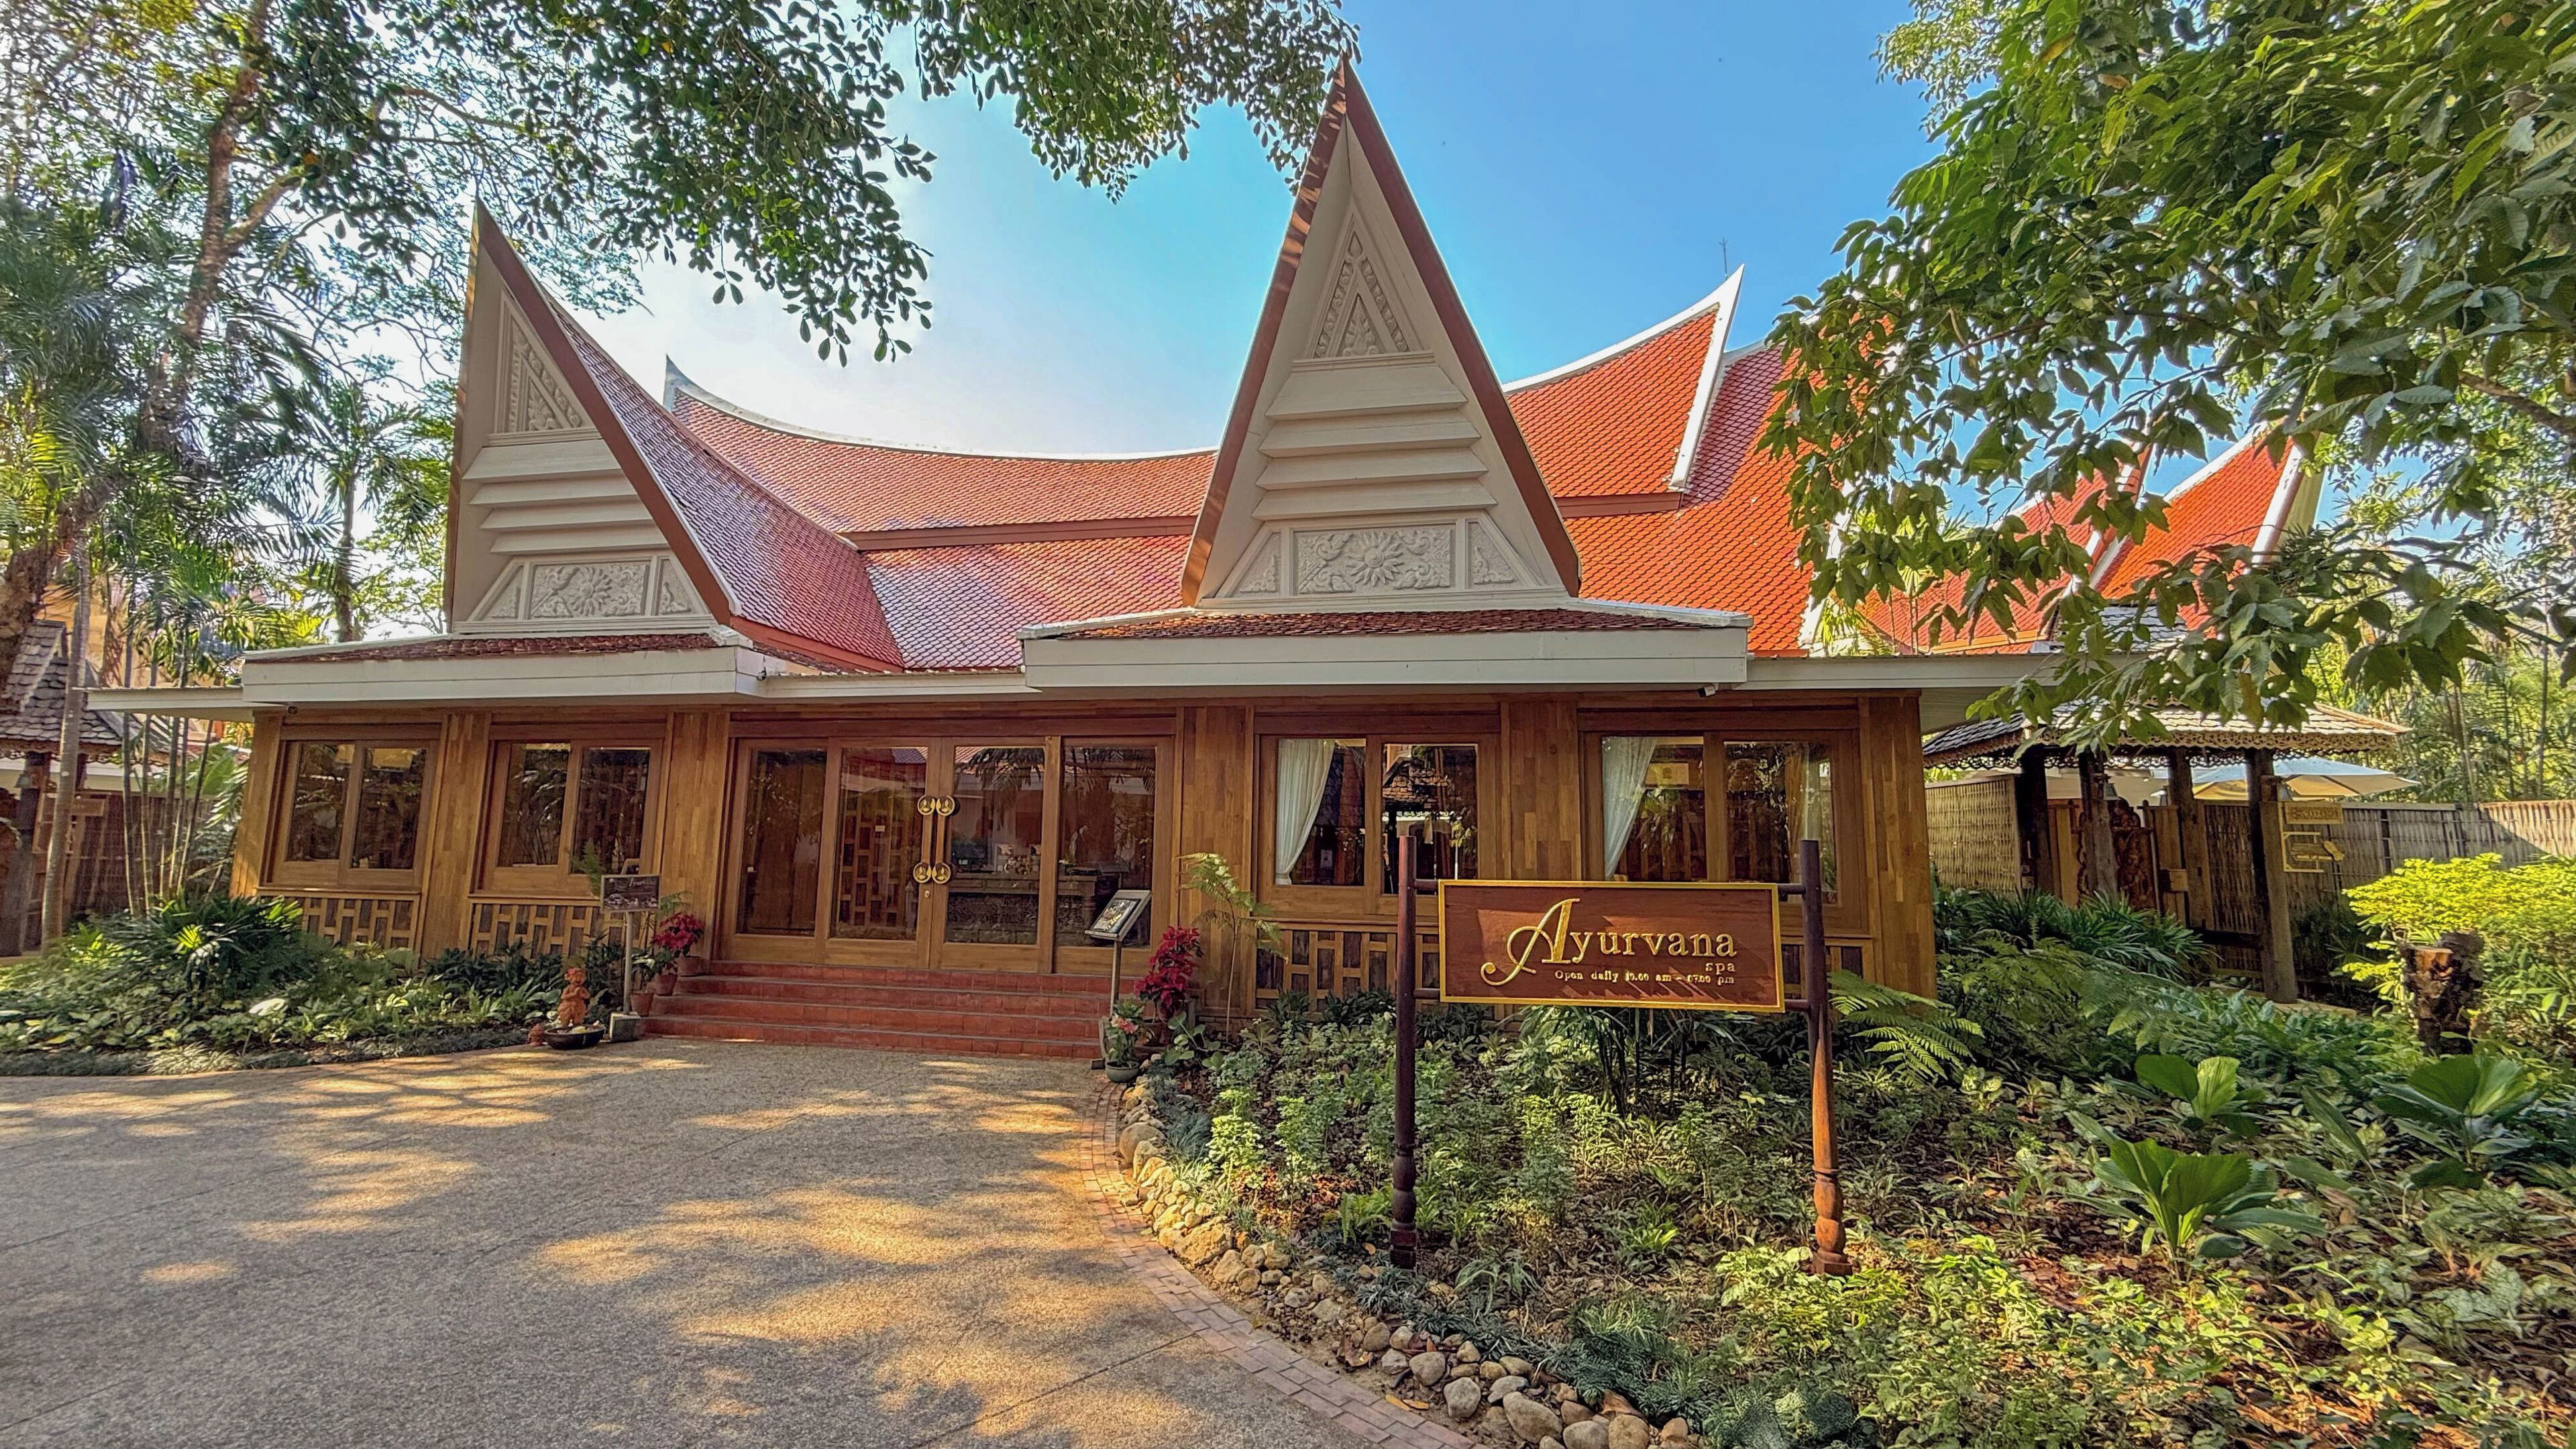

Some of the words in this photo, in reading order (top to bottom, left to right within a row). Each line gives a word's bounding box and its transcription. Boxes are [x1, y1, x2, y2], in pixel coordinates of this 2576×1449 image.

[1480, 898, 1737, 986] Ayurvana
[1705, 962, 1736, 975] spa
[1554, 970, 1584, 981] Open
[1591, 970, 1619, 983] daily
[1655, 974, 1672, 982] am
[1717, 976, 1734, 985] pm
